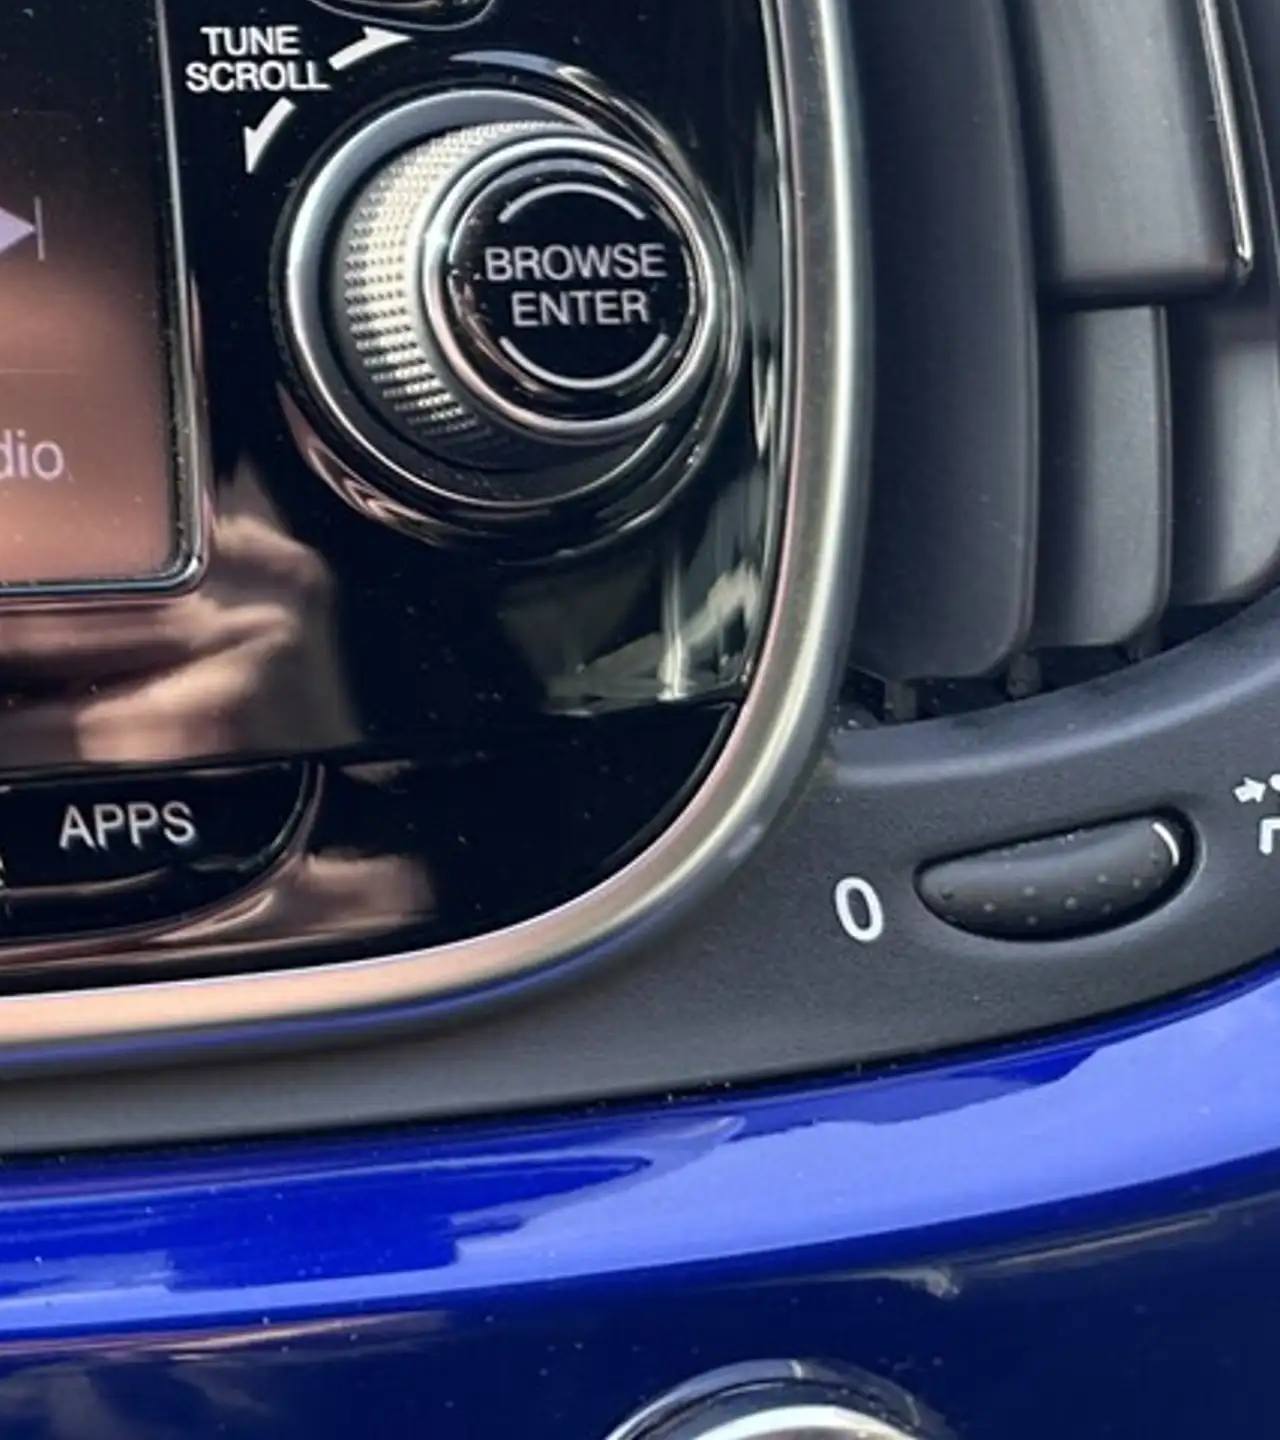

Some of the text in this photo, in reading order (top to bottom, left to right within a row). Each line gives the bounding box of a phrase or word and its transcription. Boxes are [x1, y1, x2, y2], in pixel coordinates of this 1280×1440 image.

[200, 26, 301, 56] TUNE
[184, 62, 330, 92] SCROLL
[483, 243, 667, 282] BROWSE
[510, 289, 650, 328] ENTER
[58, 801, 196, 850] APPS
[834, 876, 884, 942] 0
